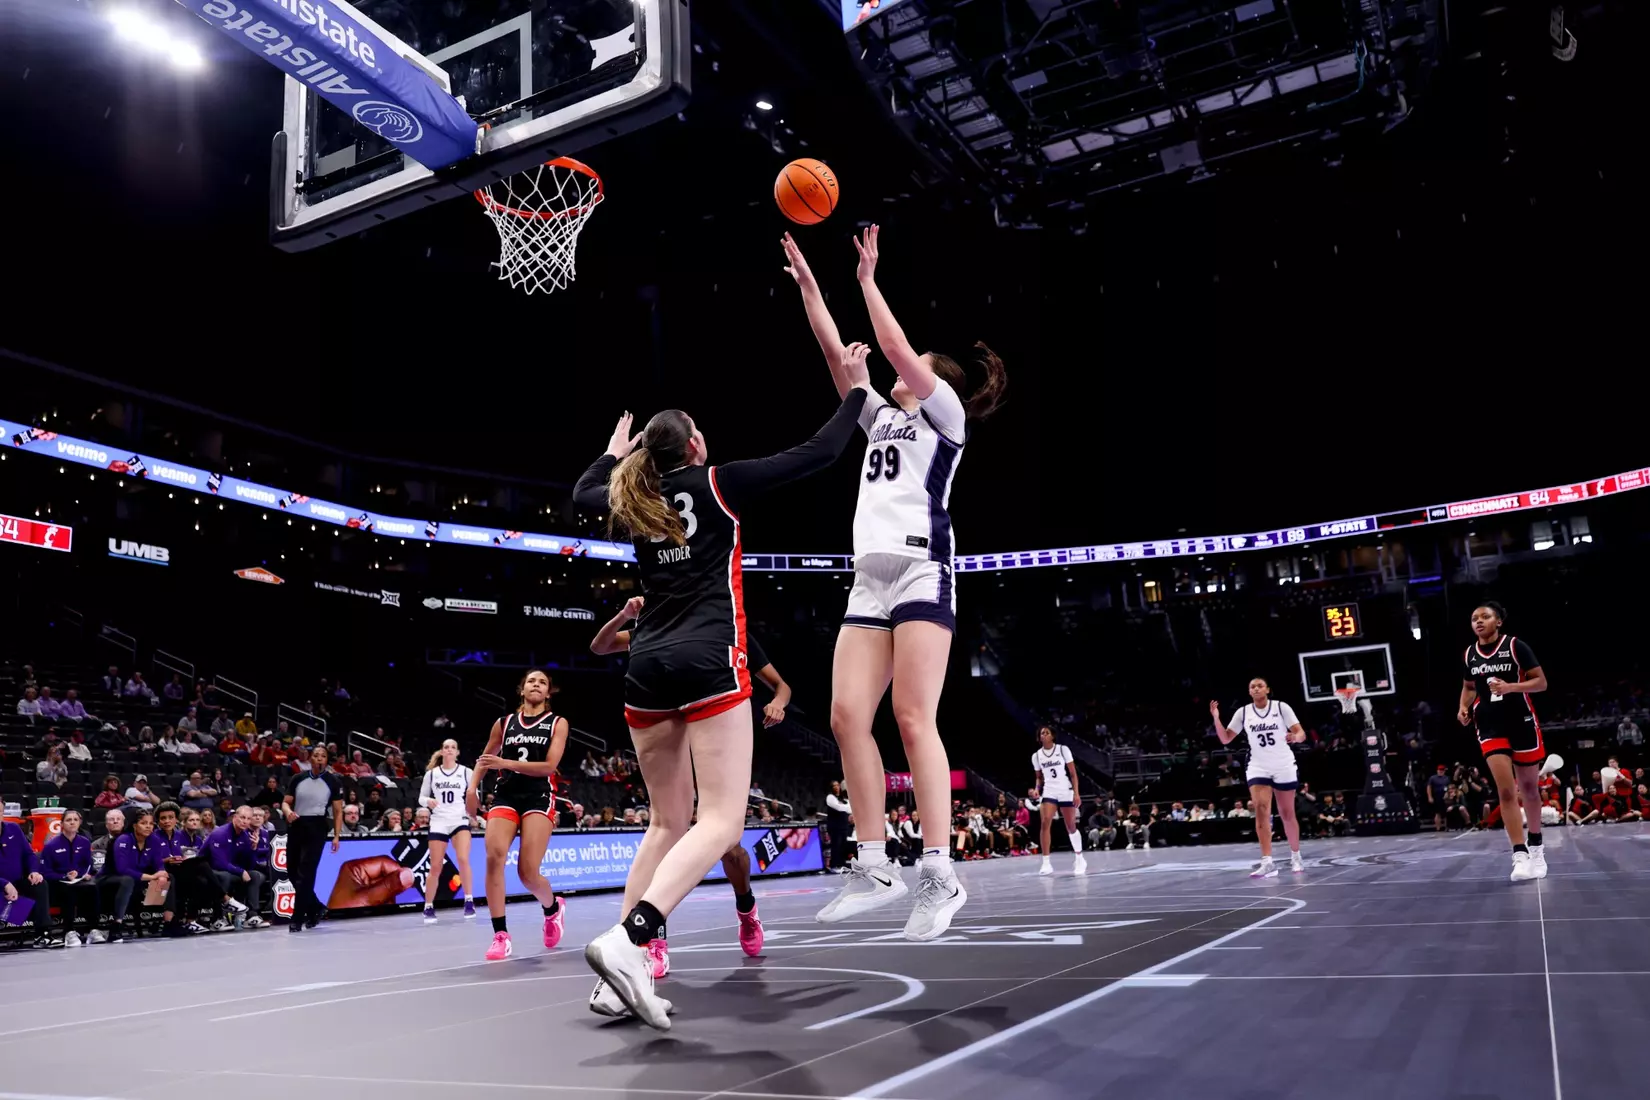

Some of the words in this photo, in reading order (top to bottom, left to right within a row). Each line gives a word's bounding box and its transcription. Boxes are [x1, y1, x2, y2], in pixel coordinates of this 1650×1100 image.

[202, 0, 371, 96] Allstate
[871, 423, 917, 444] ildcats
[57, 441, 107, 463] venmo
[866, 444, 901, 483] 99
[152, 464, 197, 485] venmo
[236, 485, 276, 504] venmo
[310, 503, 346, 521] venmo
[1449, 497, 1519, 517] CINCINNATI
[1320, 519, 1368, 536] K-STATE
[108, 537, 170, 562] UMB
[657, 545, 691, 565] SNYDER
[533, 606, 562, 618] Mobile
[563, 610, 592, 620] CENTER
[1330, 616, 1355, 636] 23
[1470, 663, 1512, 675] CINCINNATI
[1249, 722, 1279, 732] Wildcats
[505, 733, 548, 745] CINCINNATI
[1257, 732, 1276, 747] 35
[1049, 768, 1057, 779] 3
[434, 781, 462, 790] Wildcats
[441, 790, 455, 803] 10
[277, 850, 287, 865] 6
[542, 848, 577, 864] more
[578, 842, 609, 862] with
[611, 840, 634, 860] the
[558, 863, 594, 878] always-on
[595, 861, 611, 873] cash
[612, 859, 628, 872] back
